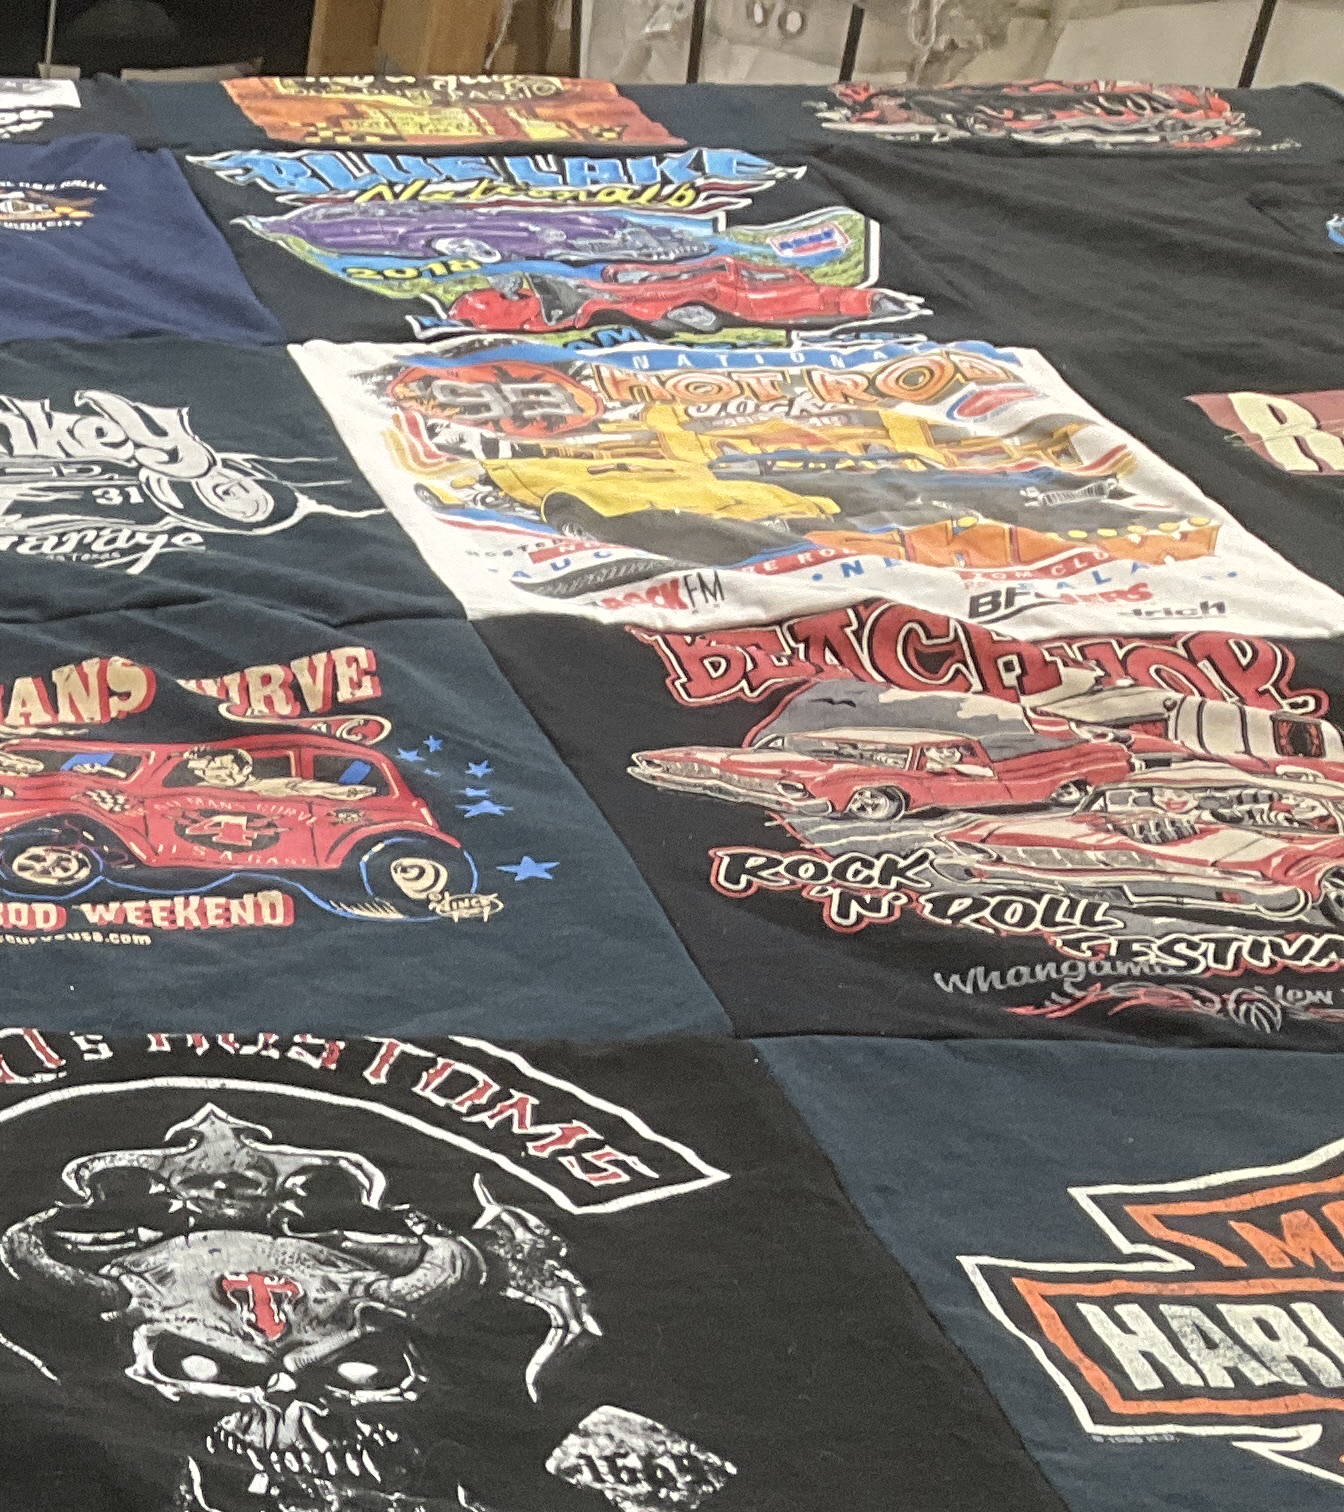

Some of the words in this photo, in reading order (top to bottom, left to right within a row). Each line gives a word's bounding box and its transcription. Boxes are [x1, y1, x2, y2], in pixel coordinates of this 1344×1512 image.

[247, 152, 501, 193] BLUE
[504, 148, 774, 187] LAKE
[345, 260, 480, 279] 2018
[595, 364, 790, 402] HOT
[806, 350, 1021, 402] ROD
[710, 848, 937, 900] ROCK
[78, 890, 295, 930] WEEKEND
